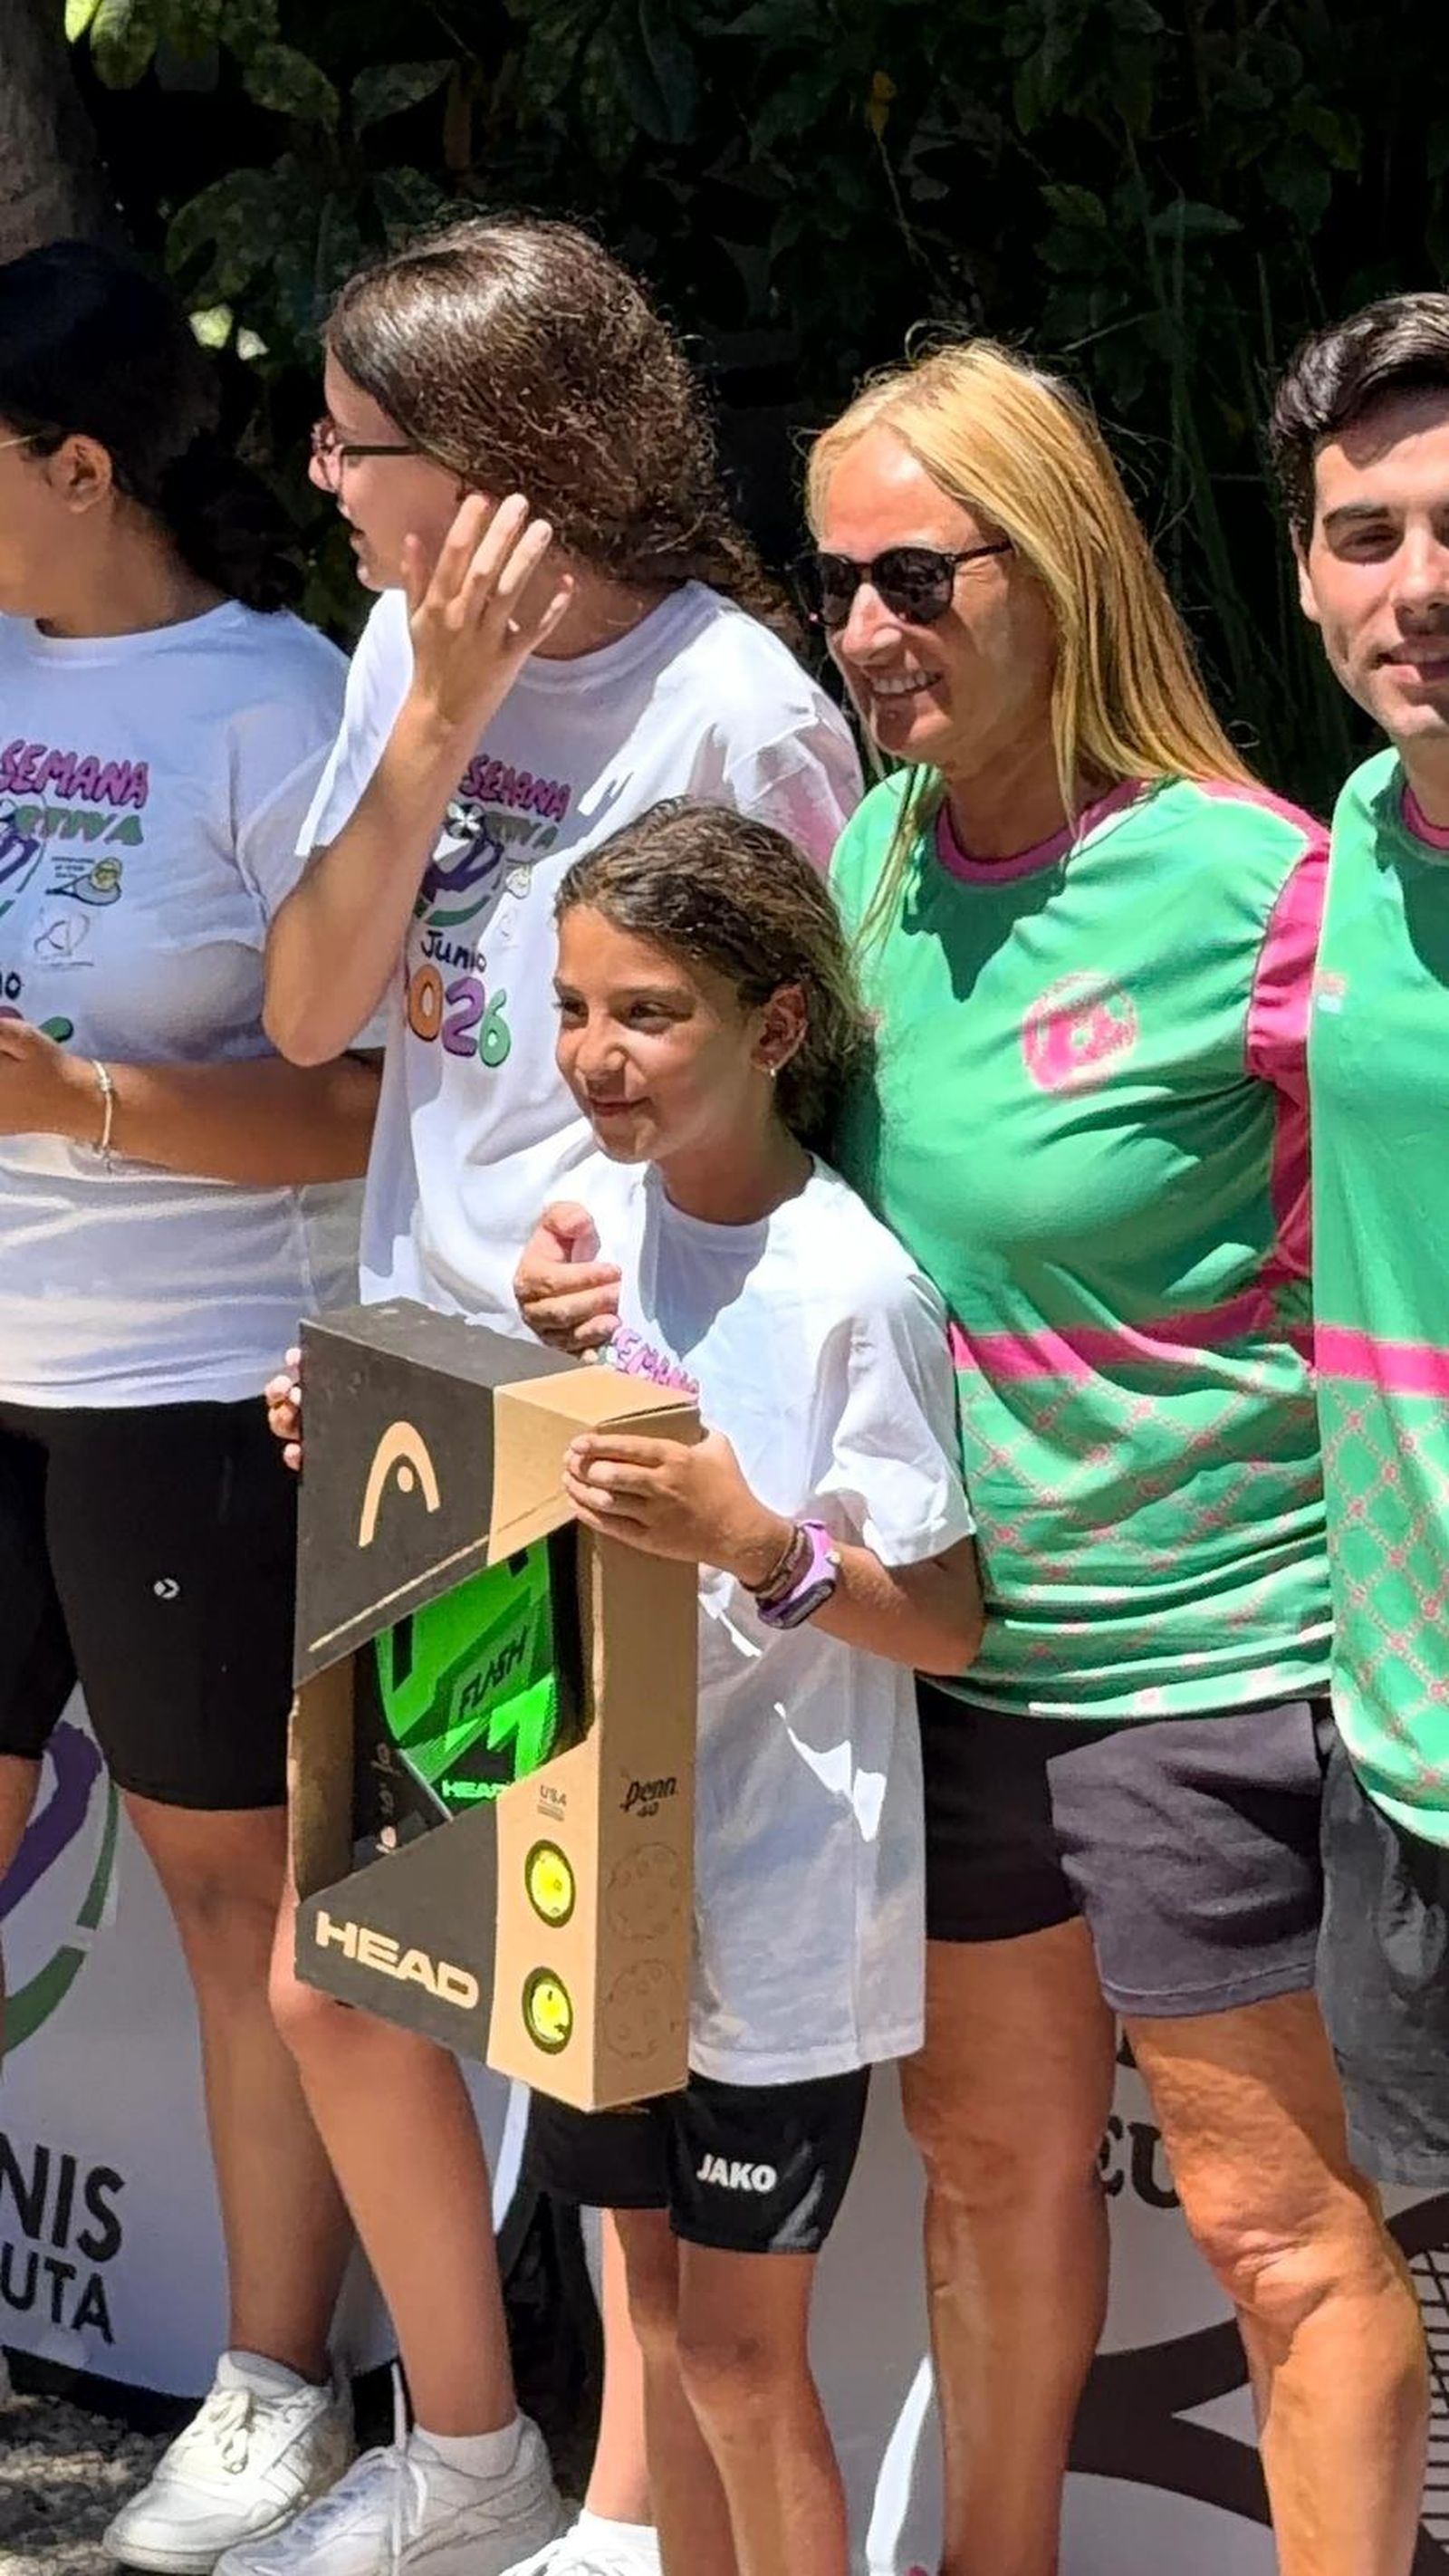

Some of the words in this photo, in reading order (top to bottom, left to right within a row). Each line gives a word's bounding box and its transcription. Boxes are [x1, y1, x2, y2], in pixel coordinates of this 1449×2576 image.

[0, 739, 149, 809] SEMANA
[458, 754, 571, 822] SEMANA
[406, 963, 511, 1067] 026
[457, 1624, 531, 1720] FLASH
[315, 1910, 479, 2010] HEAD
[696, 2153, 777, 2193] JAKO
